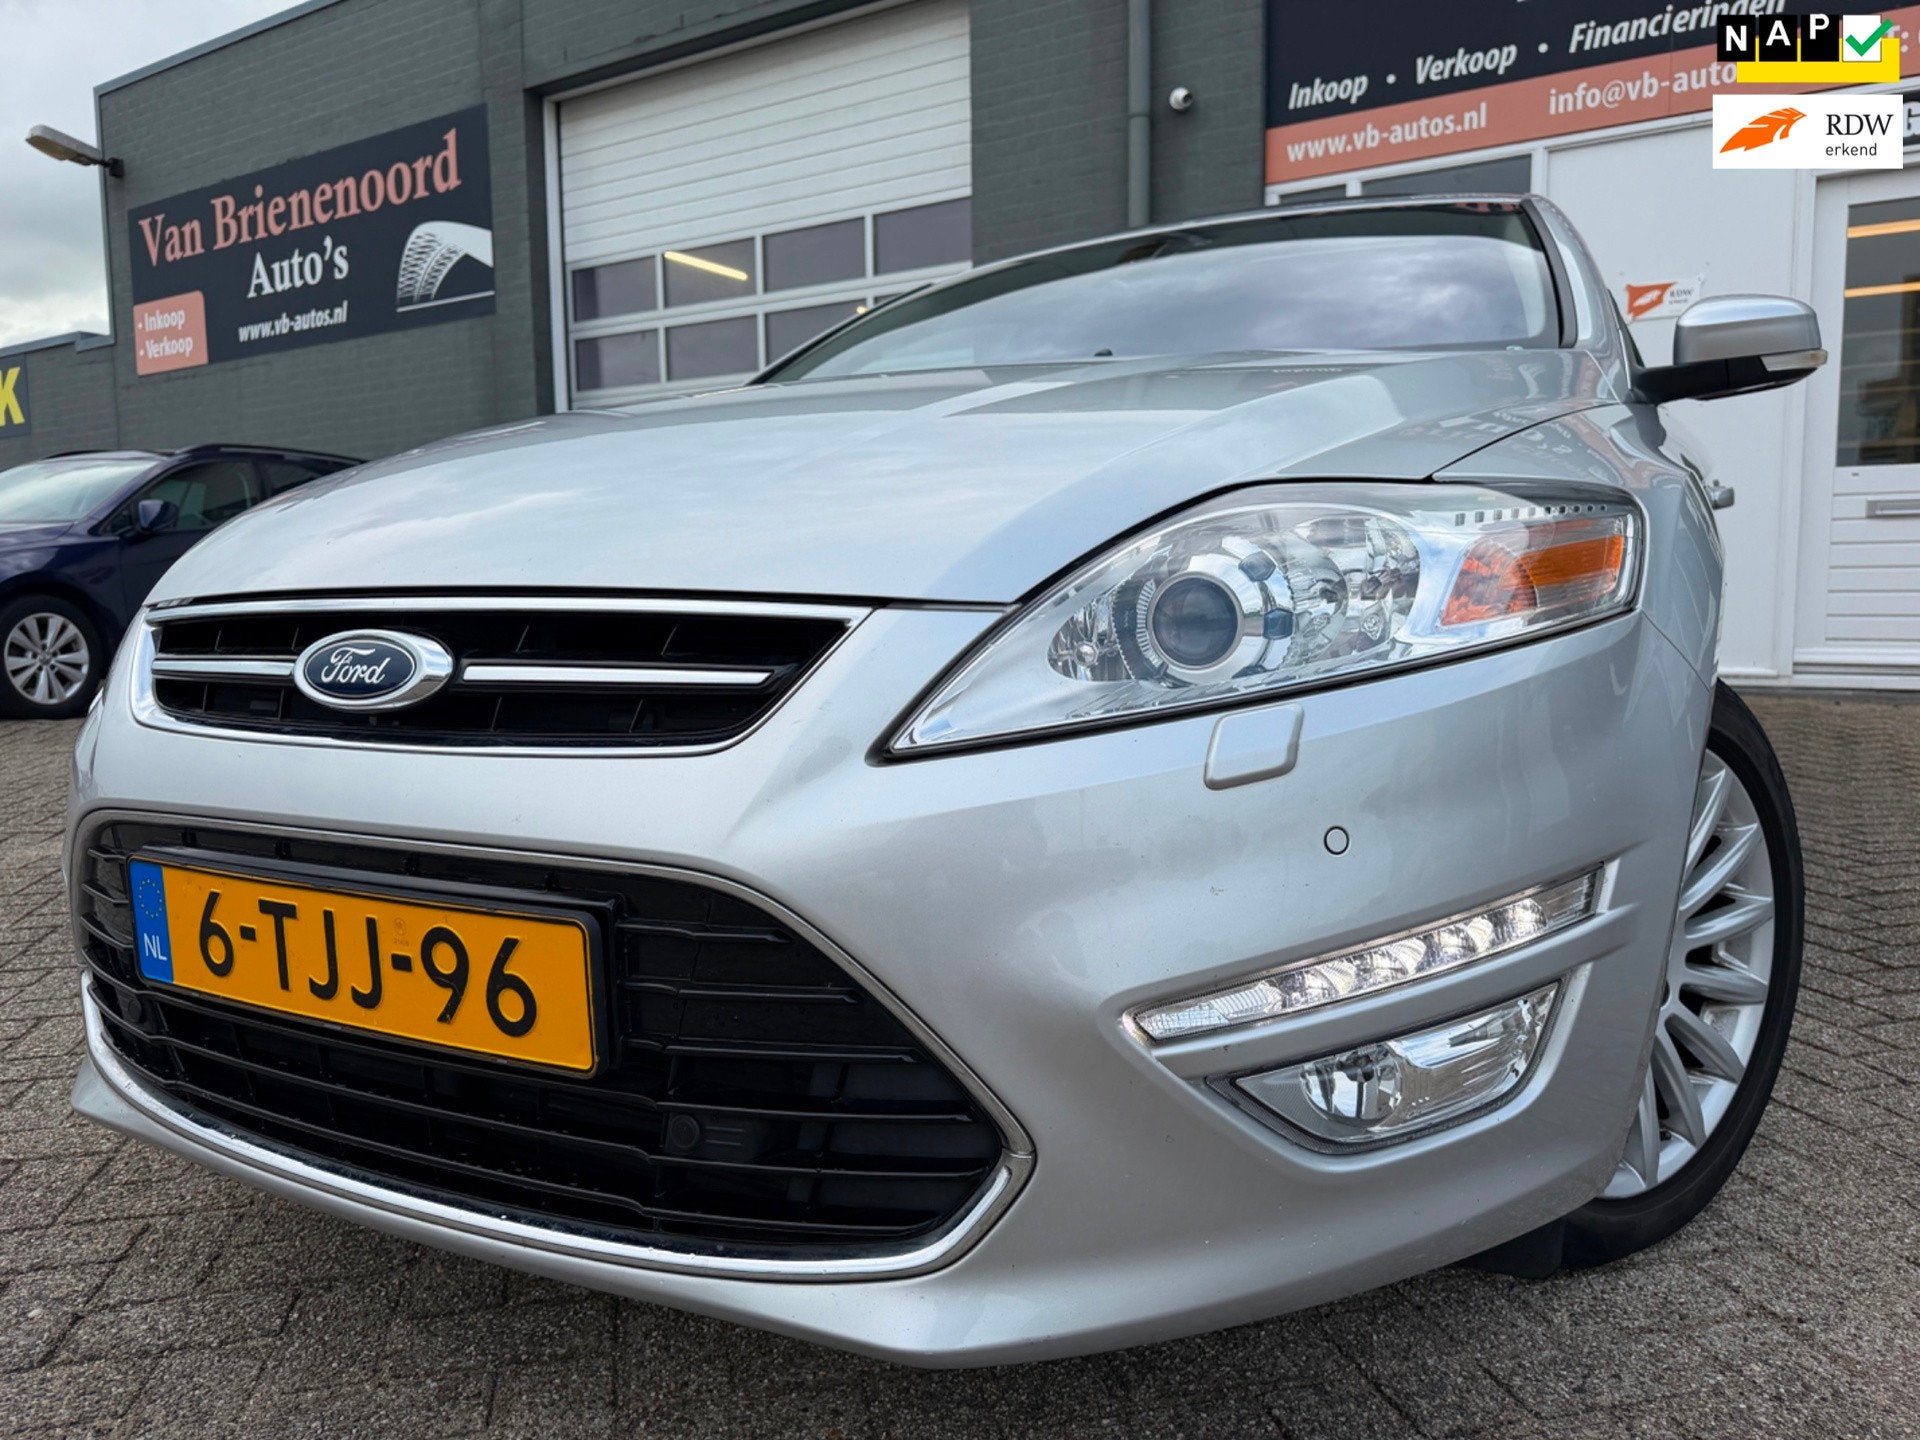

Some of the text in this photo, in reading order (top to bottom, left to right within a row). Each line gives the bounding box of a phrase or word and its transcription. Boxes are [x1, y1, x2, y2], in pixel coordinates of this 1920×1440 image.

[1288, 75, 1369, 110] Inkoop
[1415, 44, 1518, 85] Verkoop
[1286, 61, 1737, 162] www.vb-autos.nl info@vb-auto
[138, 127, 462, 267] Van Brienenoord
[246, 235, 350, 299] Auto's
[144, 309, 186, 333] Inkoop
[238, 300, 348, 343] www.vb-autos.nl
[145, 336, 194, 360] Verkoop
[320, 646, 391, 684] Ford
[143, 932, 168, 962] NL
[198, 889, 538, 1038] 6-TJJ-96
